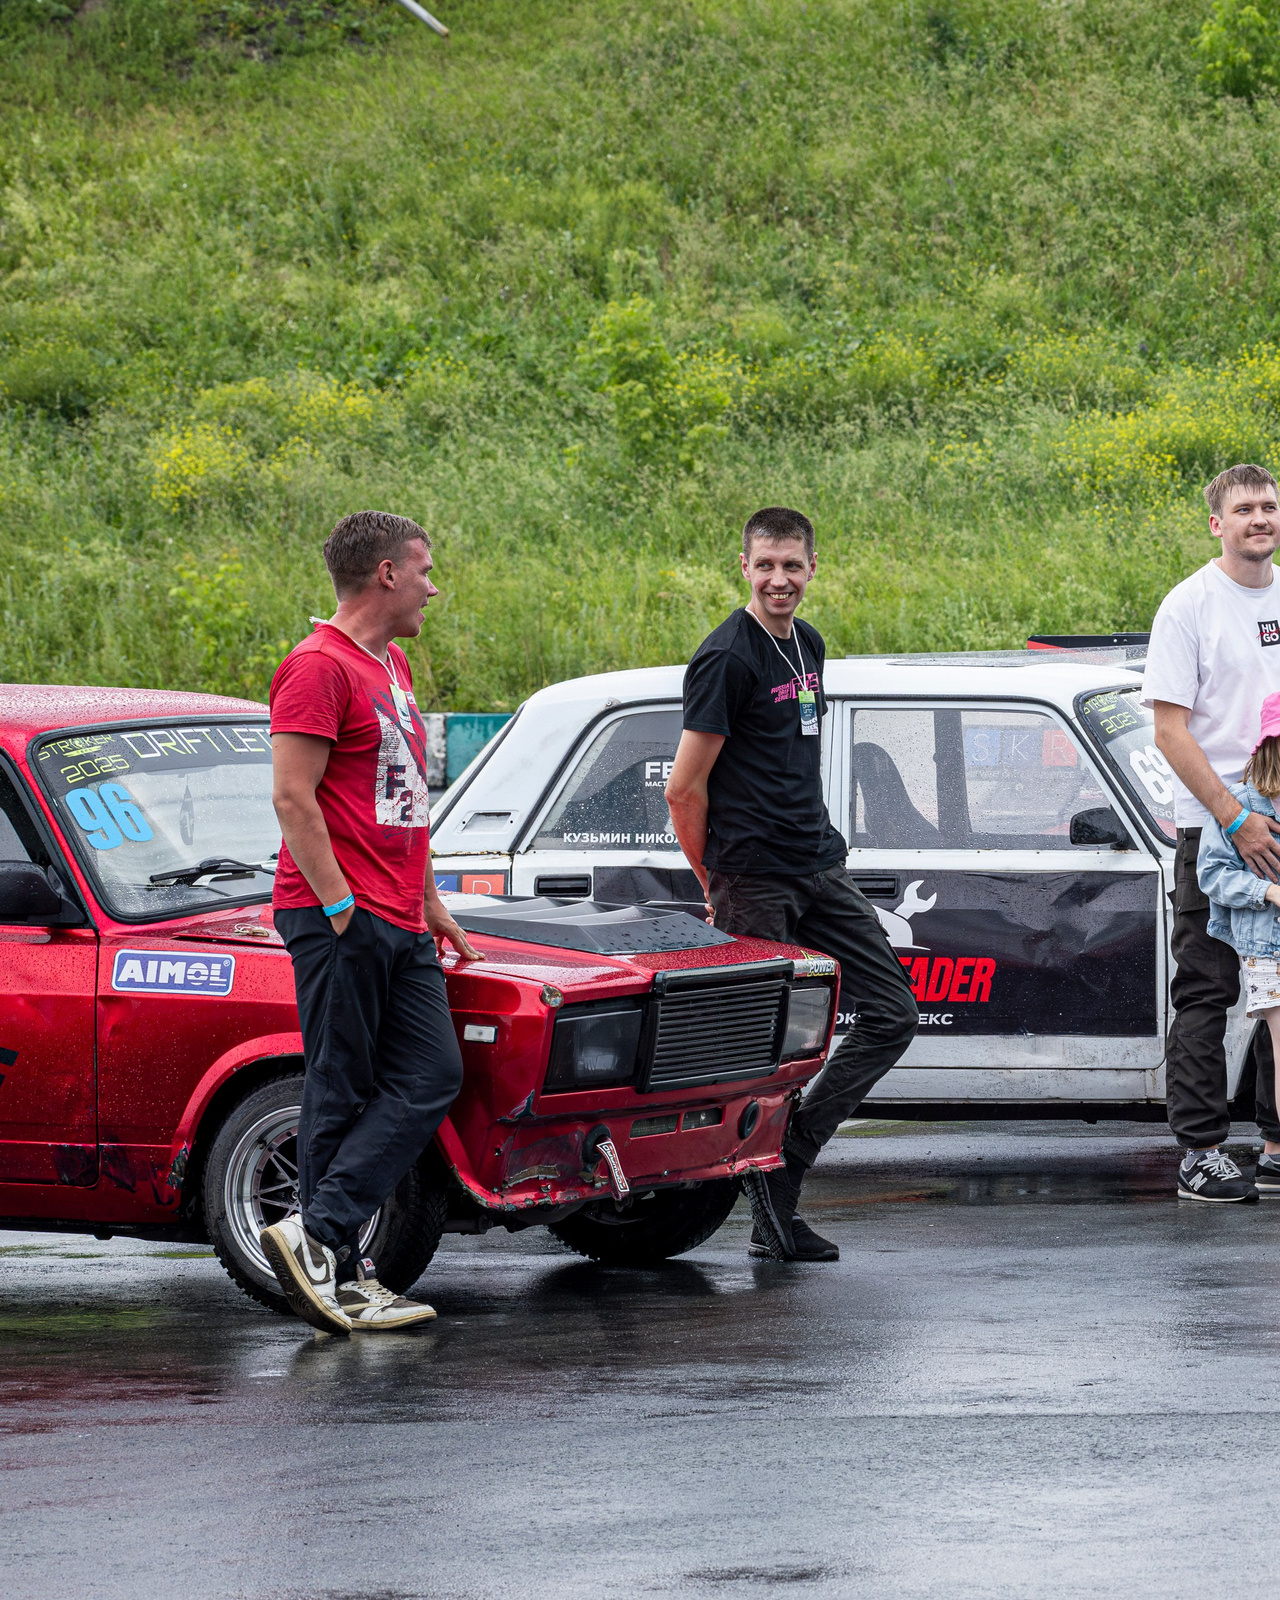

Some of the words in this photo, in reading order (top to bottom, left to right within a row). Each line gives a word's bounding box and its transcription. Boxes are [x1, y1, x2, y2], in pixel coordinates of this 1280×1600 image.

[1261, 623, 1276, 633] HU
[1262, 633, 1279, 643] GO
[1100, 711, 1137, 735] 2025
[120, 728, 221, 758] DRIFT
[216, 728, 271, 753] LET
[60, 755, 130, 784] 2025
[65, 782, 154, 850] 96
[563, 832, 631, 844] КУЗЬМИН
[117, 959, 227, 987] AIMOL
[808, 960, 836, 975] POWER
